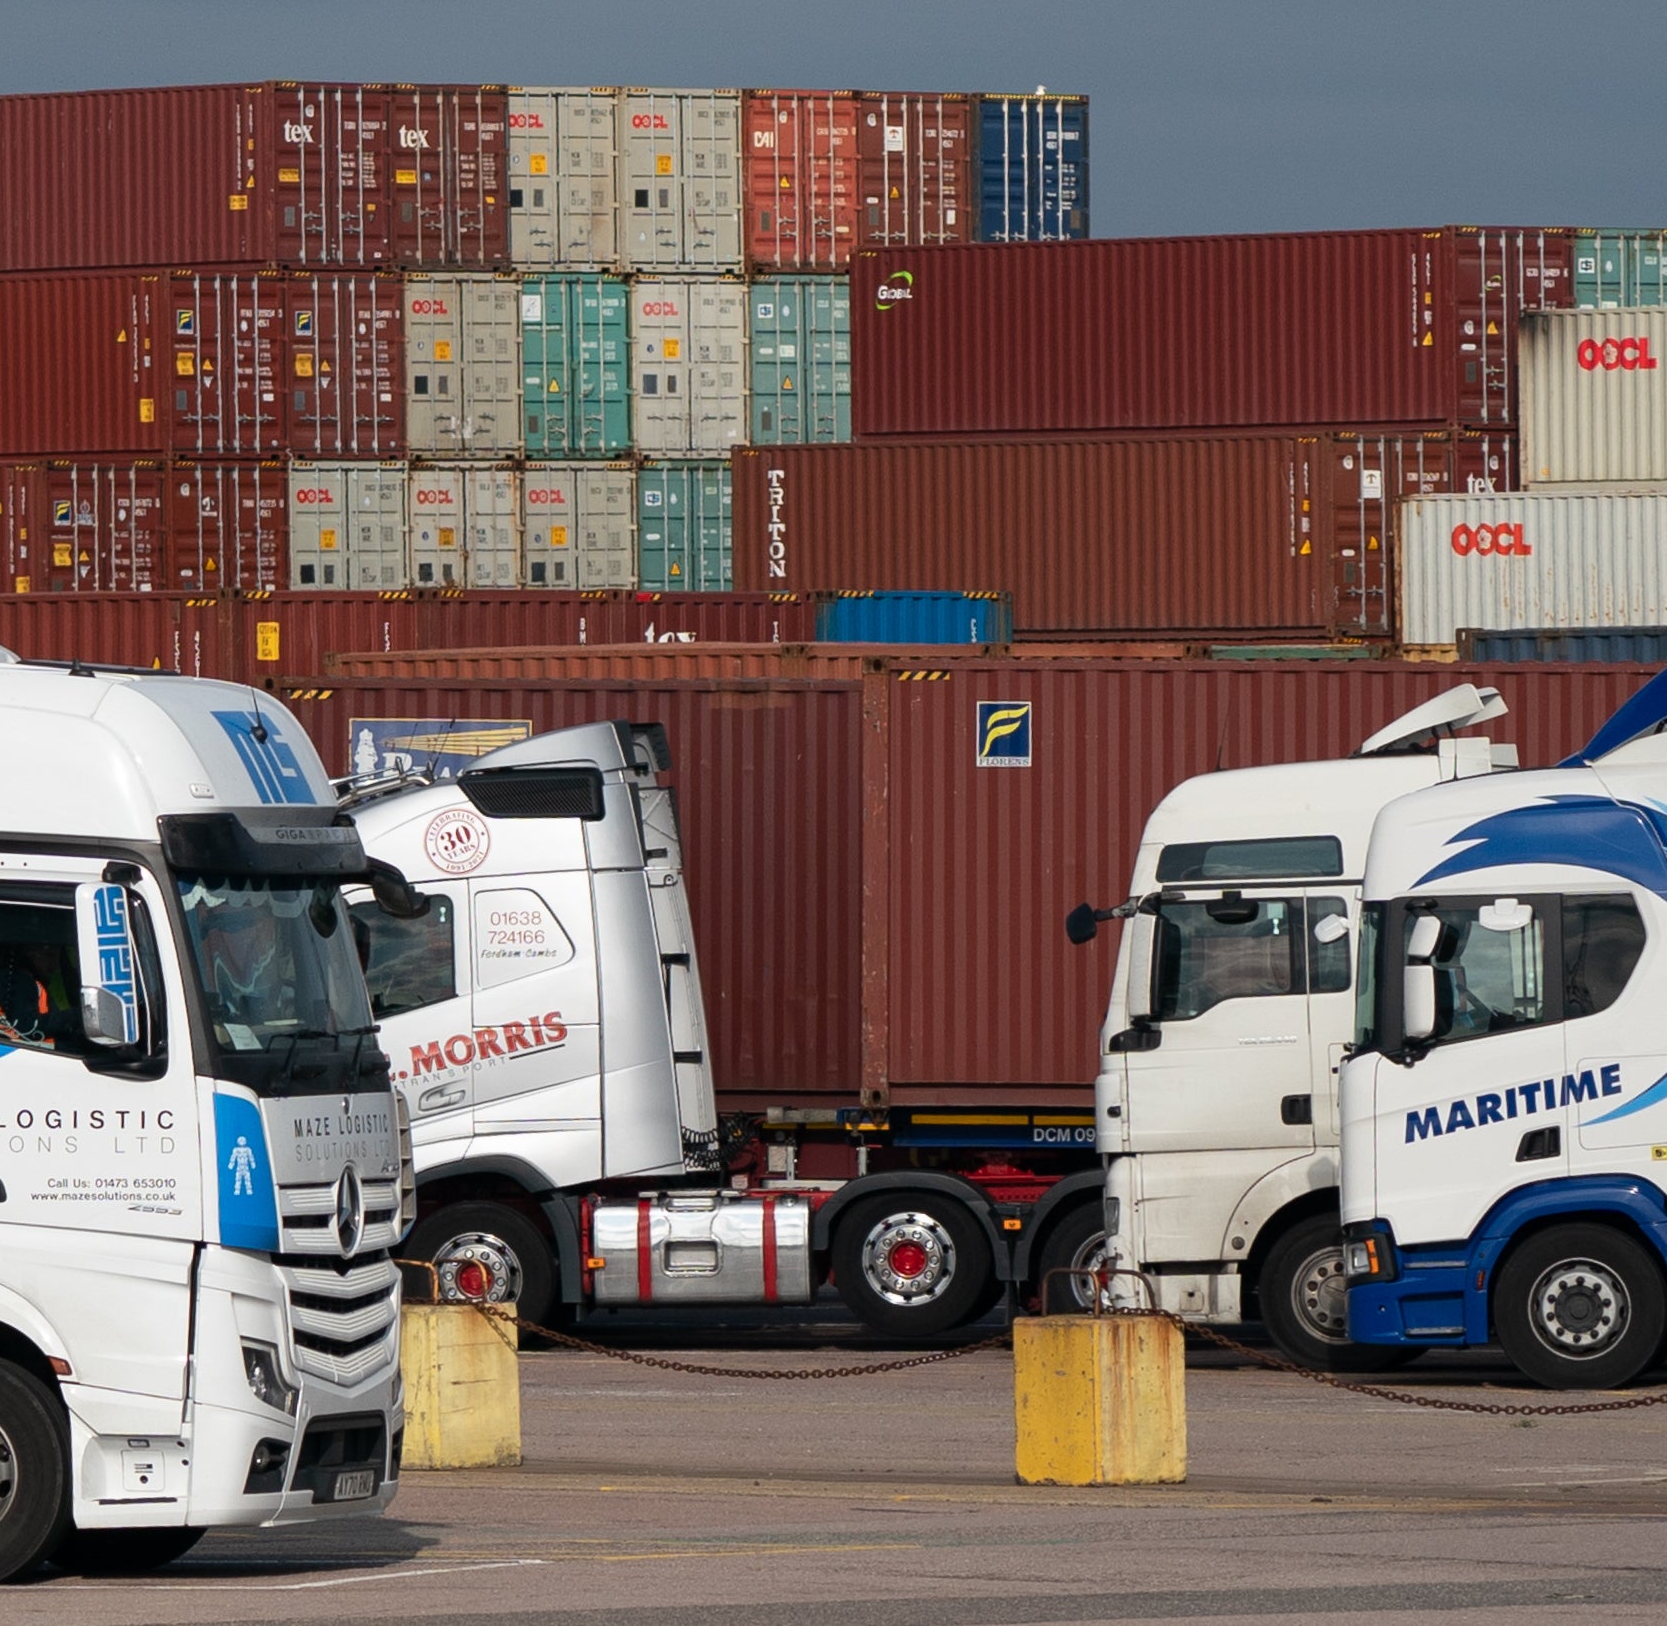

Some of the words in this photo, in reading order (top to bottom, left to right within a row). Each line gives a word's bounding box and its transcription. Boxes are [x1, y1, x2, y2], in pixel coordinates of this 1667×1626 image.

[508, 115, 544, 129] OOCL
[632, 115, 668, 129] OOCL
[283, 119, 315, 143] tex
[399, 125, 431, 149] tex
[412, 300, 448, 314] OOCL
[642, 302, 678, 316] OOCL
[1577, 337, 1658, 371] OOCL
[296, 489, 334, 503] OOCL
[416, 490, 454, 504] OOCL
[528, 490, 565, 504] OOCL
[767, 470, 787, 578] TRITON
[1450, 522, 1532, 557] OOCL
[978, 757, 1030, 766] FLORENS
[441, 824, 472, 852] 30
[447, 844, 477, 861] YEARS
[490, 911, 542, 926] 01638
[488, 930, 545, 945] 724166
[402, 1056, 511, 1090] TRANSPORT
[1404, 1064, 1623, 1144] MARITIME
[294, 1117, 330, 1138] MAZE
[338, 1114, 388, 1134] LOGISTIC
[1033, 1127, 1069, 1143] DCM
[113, 1135, 177, 1155] LTD
[296, 1141, 367, 1162] SOLUTIONS
[47, 1177, 68, 1188] Call
[73, 1178, 91, 1188] Us:
[95, 1178, 129, 1189] 01473
[133, 1178, 177, 1189] 653010
[31, 1191, 176, 1202] www.mazesolutions.co.uk
